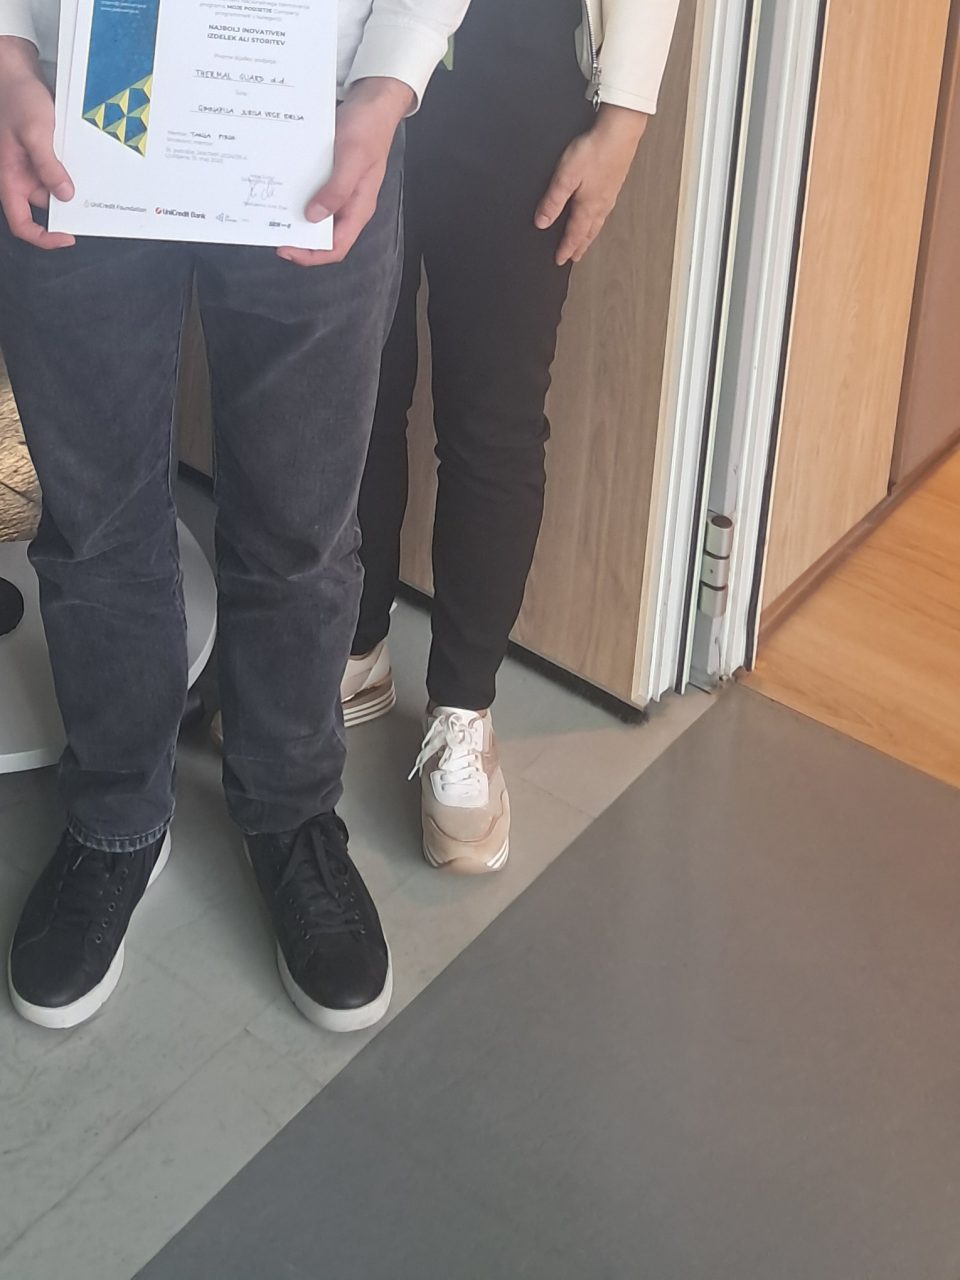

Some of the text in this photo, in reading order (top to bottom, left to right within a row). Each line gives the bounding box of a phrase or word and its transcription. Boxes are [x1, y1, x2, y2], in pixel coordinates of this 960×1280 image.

[208, 24, 286, 37] NAJBOLJ INOVATIVEN
[207, 33, 237, 42] IZDELEK
[251, 37, 286, 46] STORITEV
[162, 208, 206, 220] UniCredit Bank
